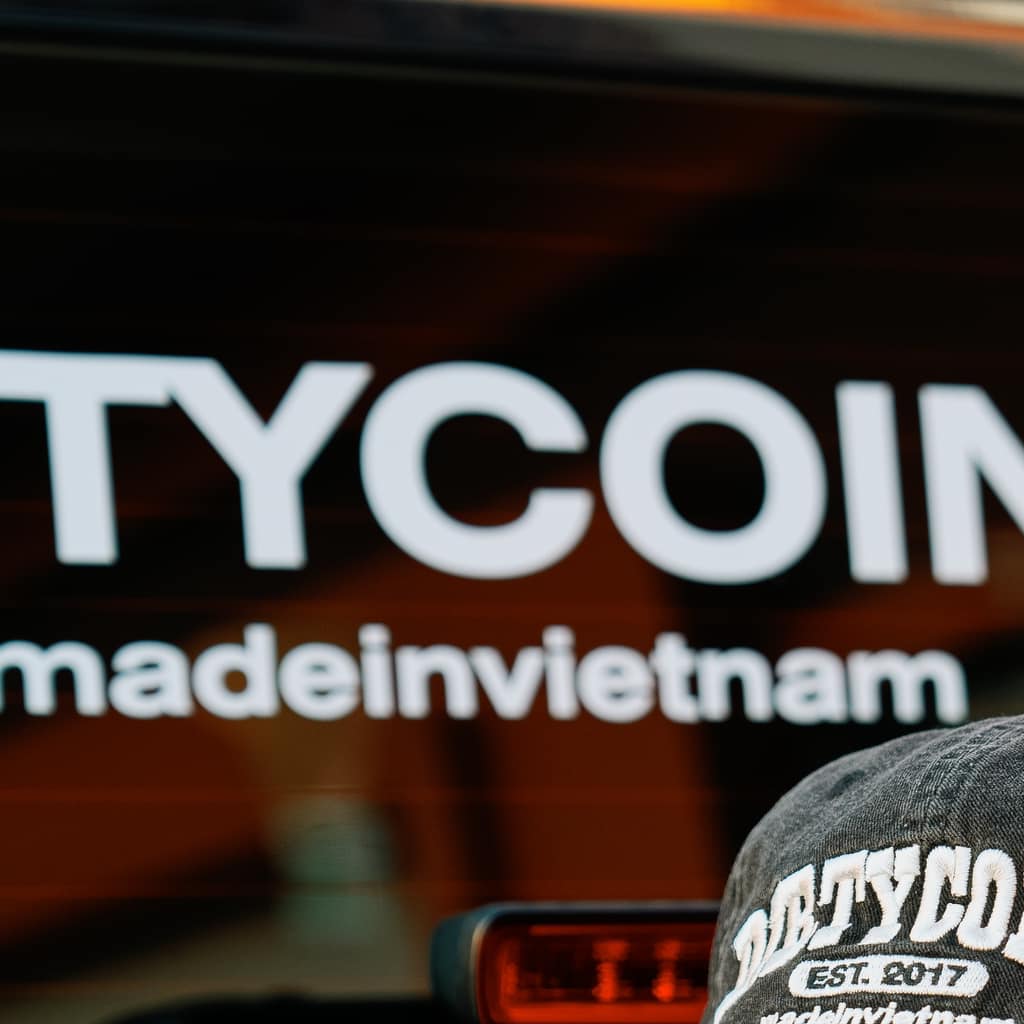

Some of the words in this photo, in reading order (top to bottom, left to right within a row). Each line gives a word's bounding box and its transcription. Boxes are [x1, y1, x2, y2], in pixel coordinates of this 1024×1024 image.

[0, 623, 967, 724] madeinvietnam
[805, 961, 869, 989] EST.
[880, 961, 969, 987] 2017
